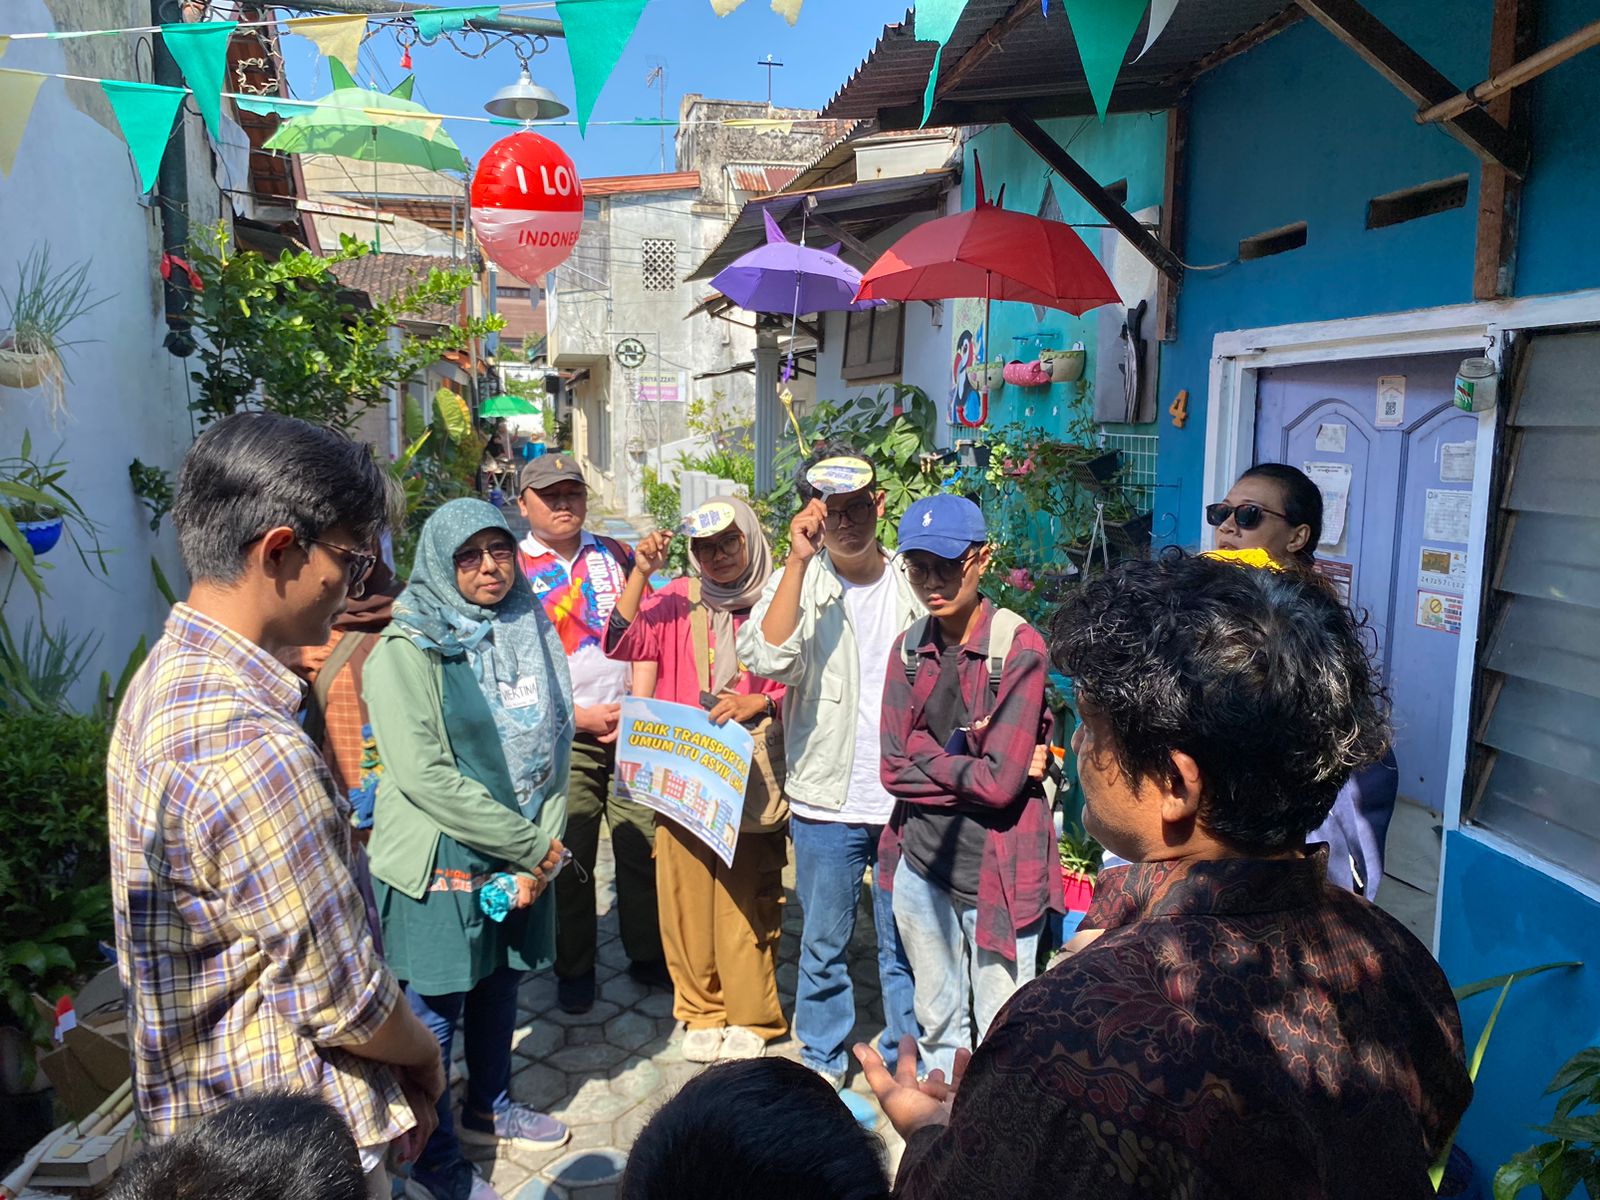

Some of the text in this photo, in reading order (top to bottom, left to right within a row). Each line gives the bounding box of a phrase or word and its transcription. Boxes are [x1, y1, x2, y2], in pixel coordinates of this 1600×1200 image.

[515, 165, 528, 194] I
[1168, 389, 1188, 429] 4
[632, 719, 670, 737] NAIK
[629, 735, 674, 754] UMUM
[676, 743, 701, 763] ITU
[700, 752, 732, 782] ASYIK
